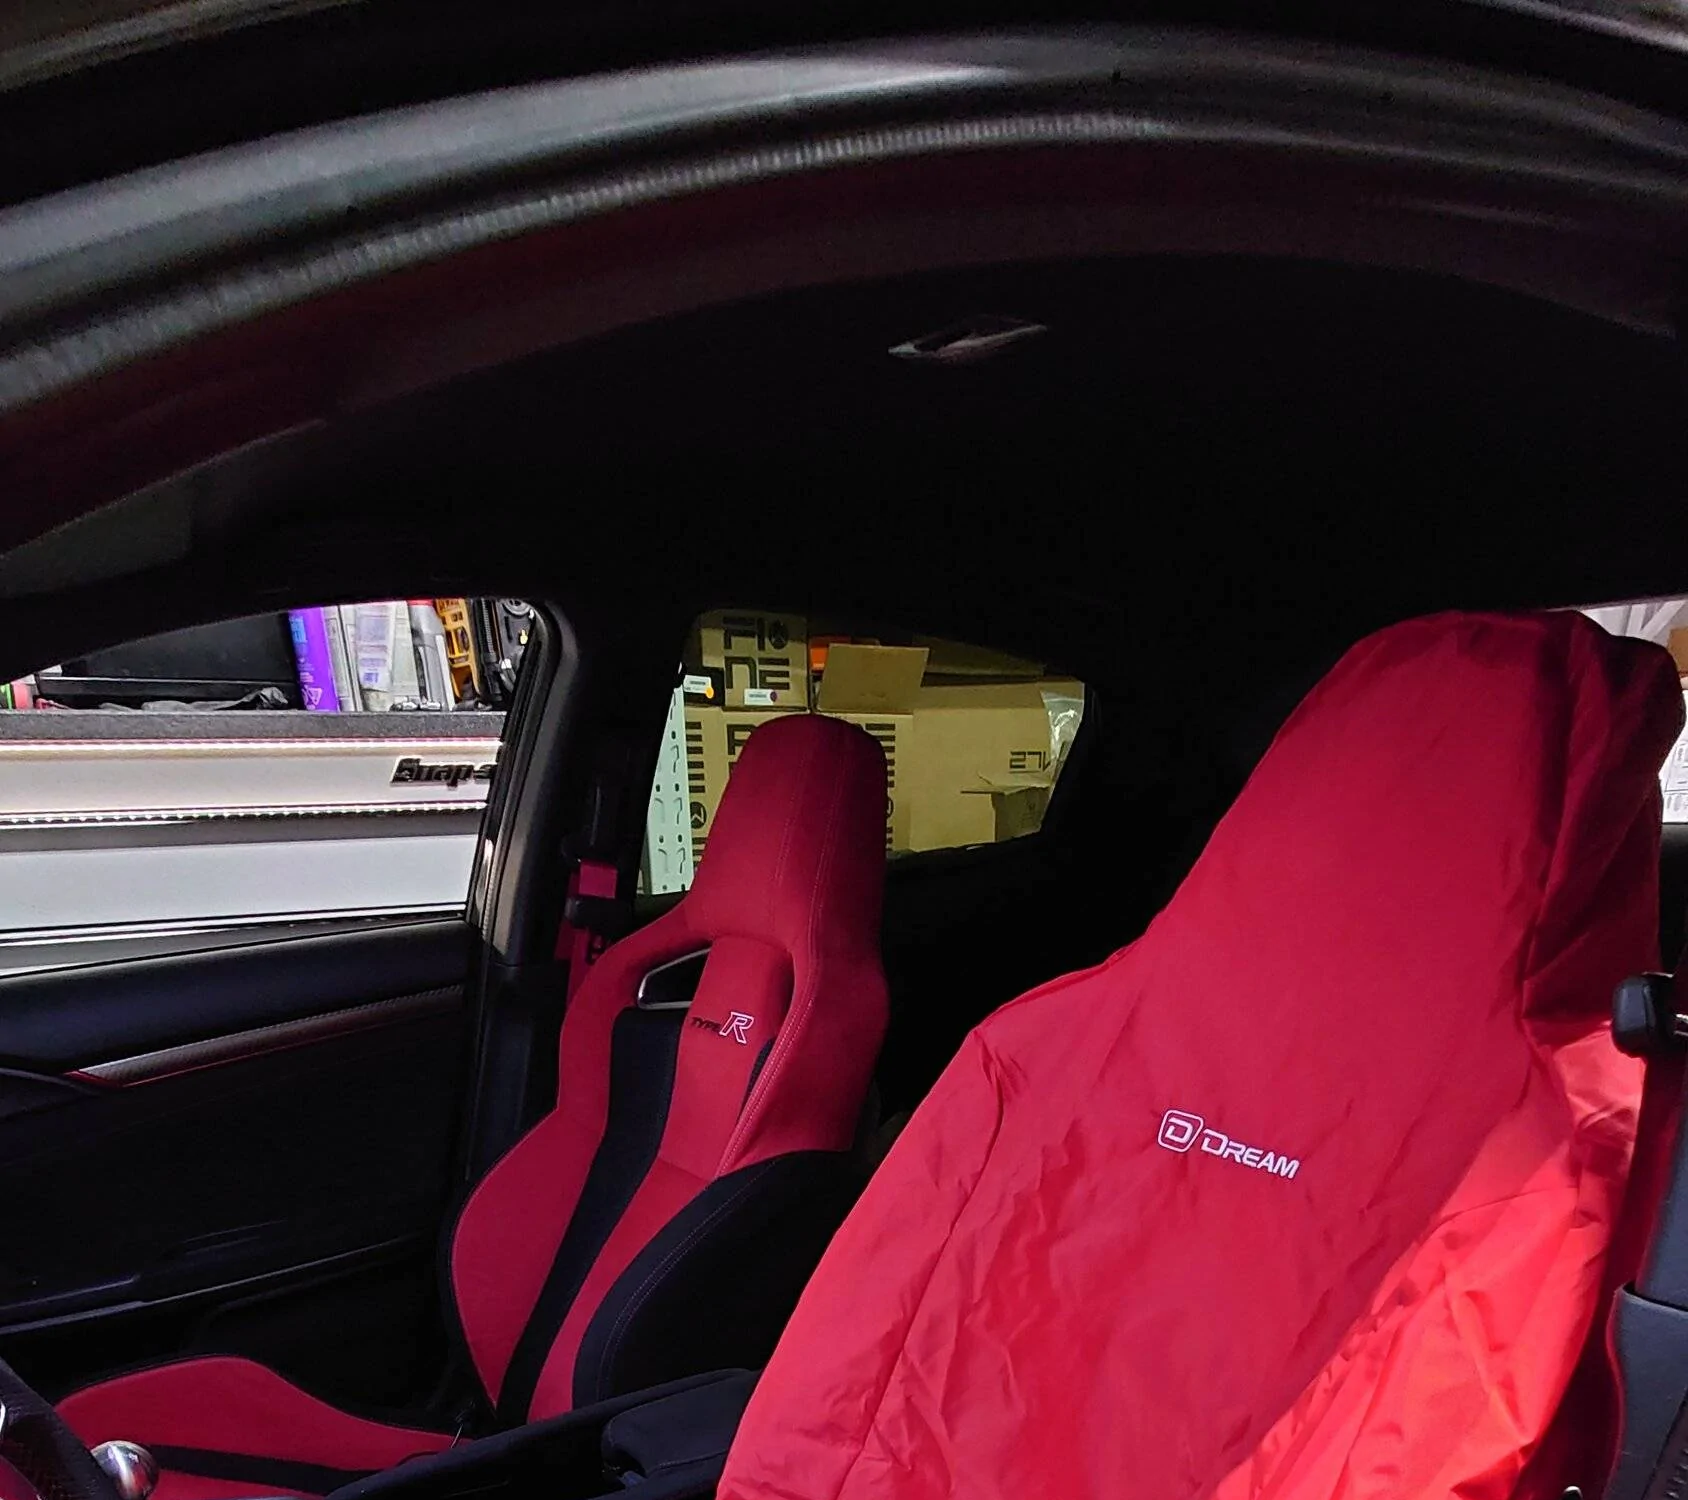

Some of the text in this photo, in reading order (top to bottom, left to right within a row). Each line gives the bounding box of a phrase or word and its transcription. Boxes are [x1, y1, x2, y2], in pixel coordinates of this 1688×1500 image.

[691, 1010, 755, 1045] TYPE R
[1200, 1128, 1299, 1179] DREAM
